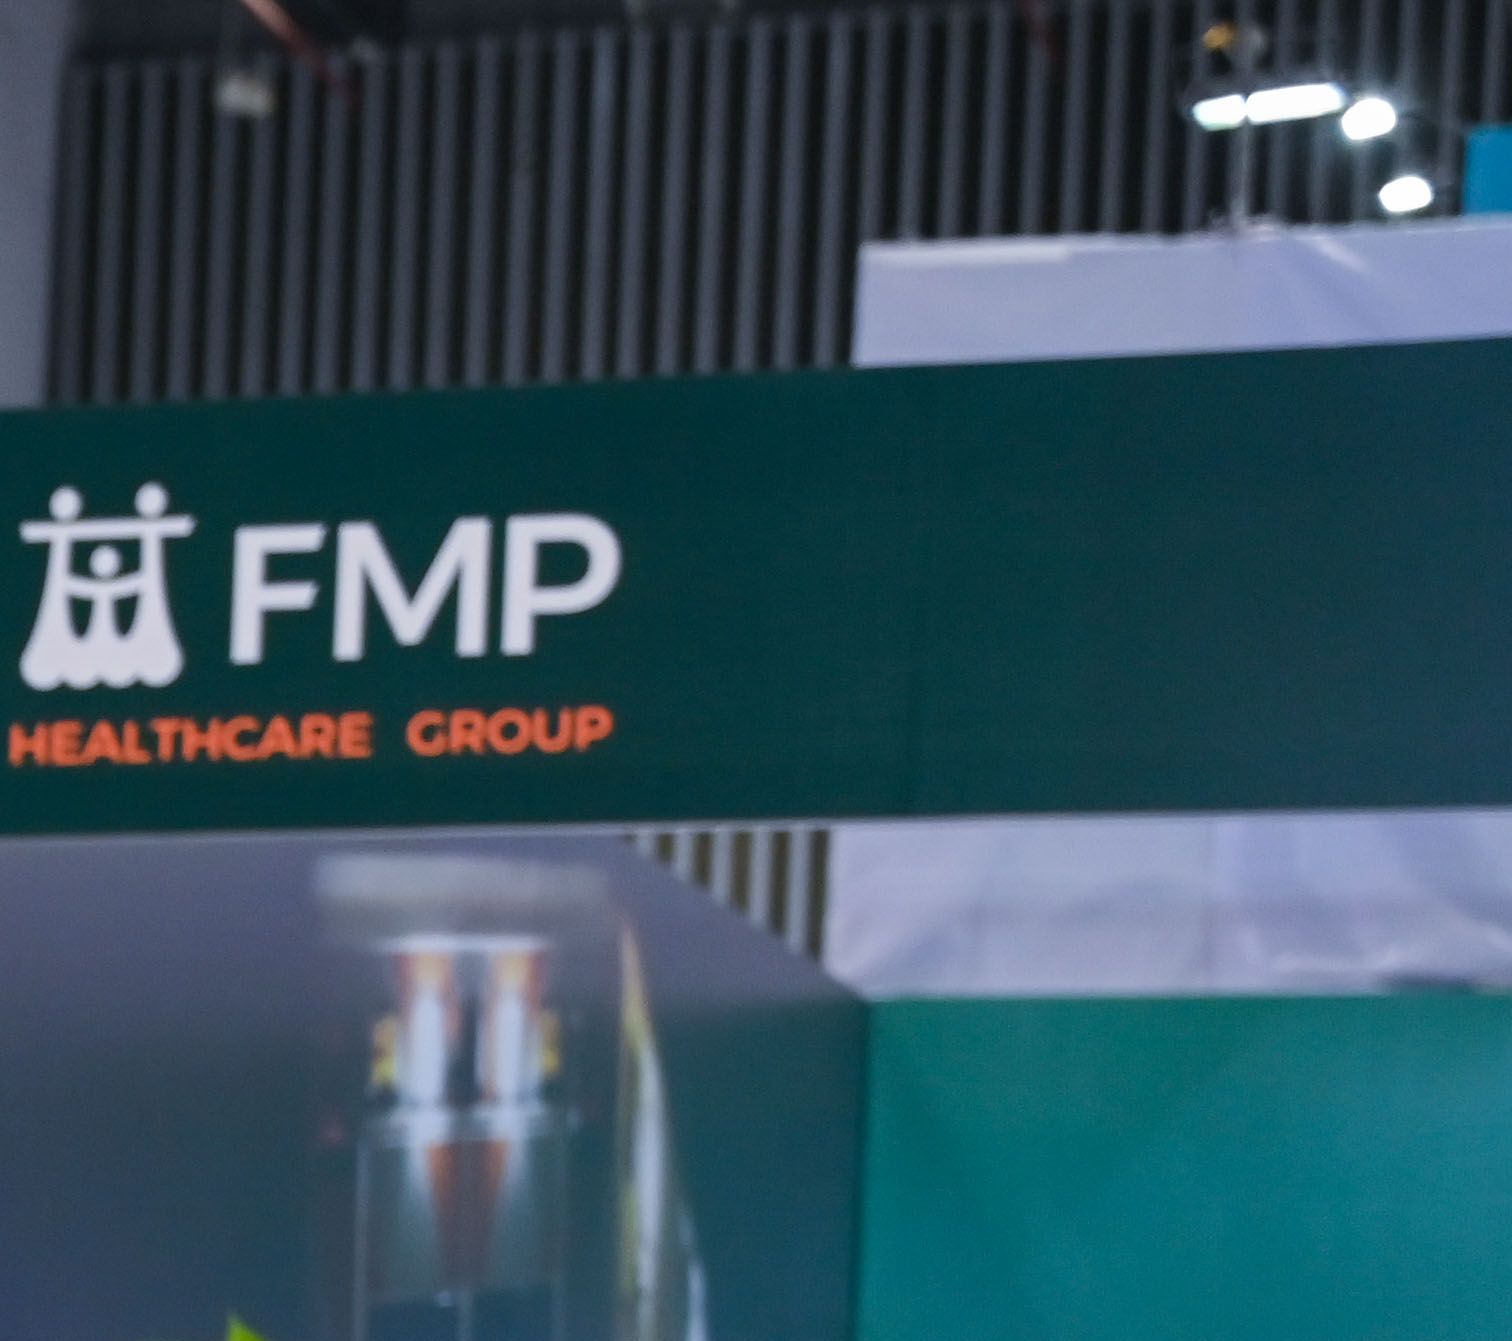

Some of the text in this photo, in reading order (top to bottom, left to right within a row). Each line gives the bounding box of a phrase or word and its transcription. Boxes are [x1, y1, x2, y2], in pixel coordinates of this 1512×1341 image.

[229, 513, 624, 666] FMP
[7, 704, 615, 767] HEALTHCARE GROUP
